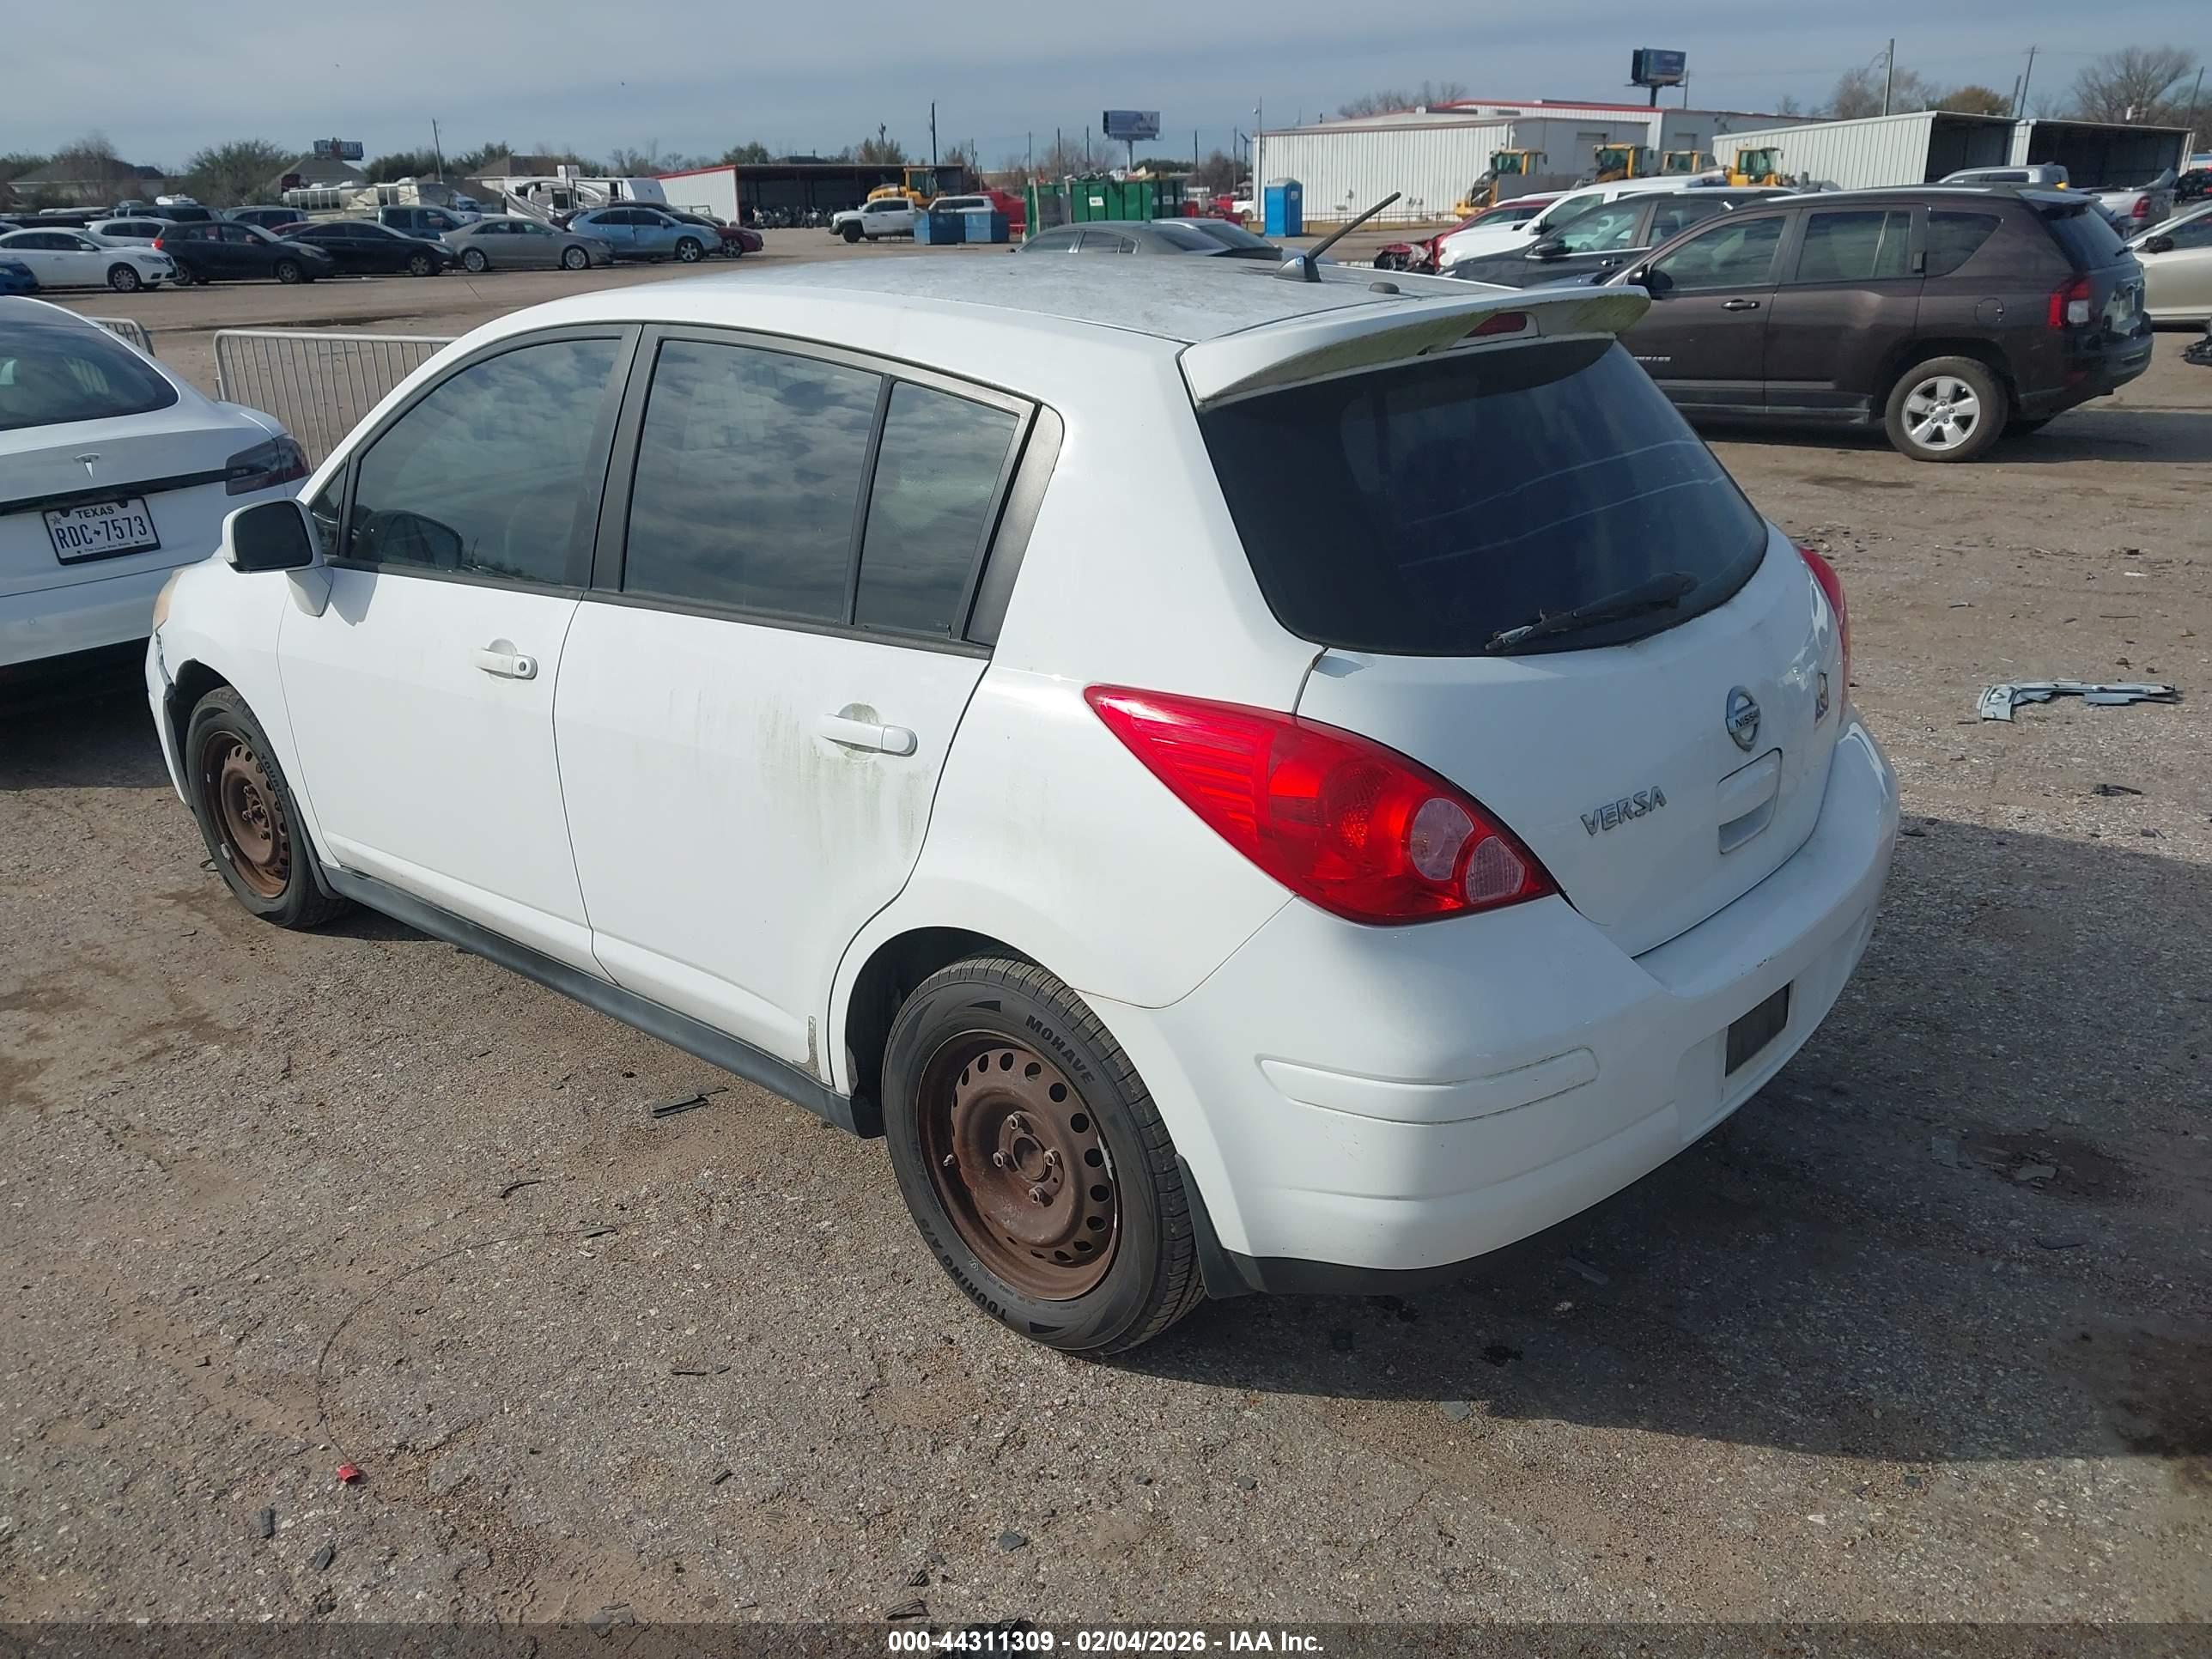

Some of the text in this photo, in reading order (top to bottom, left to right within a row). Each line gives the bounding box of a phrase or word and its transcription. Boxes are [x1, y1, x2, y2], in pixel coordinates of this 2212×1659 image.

[76, 506, 114, 519] TEXAS
[1580, 786, 1667, 836] VERSA
[1025, 1015, 1095, 1084] MOHAVE
[943, 1254, 1008, 1322] TOURING
